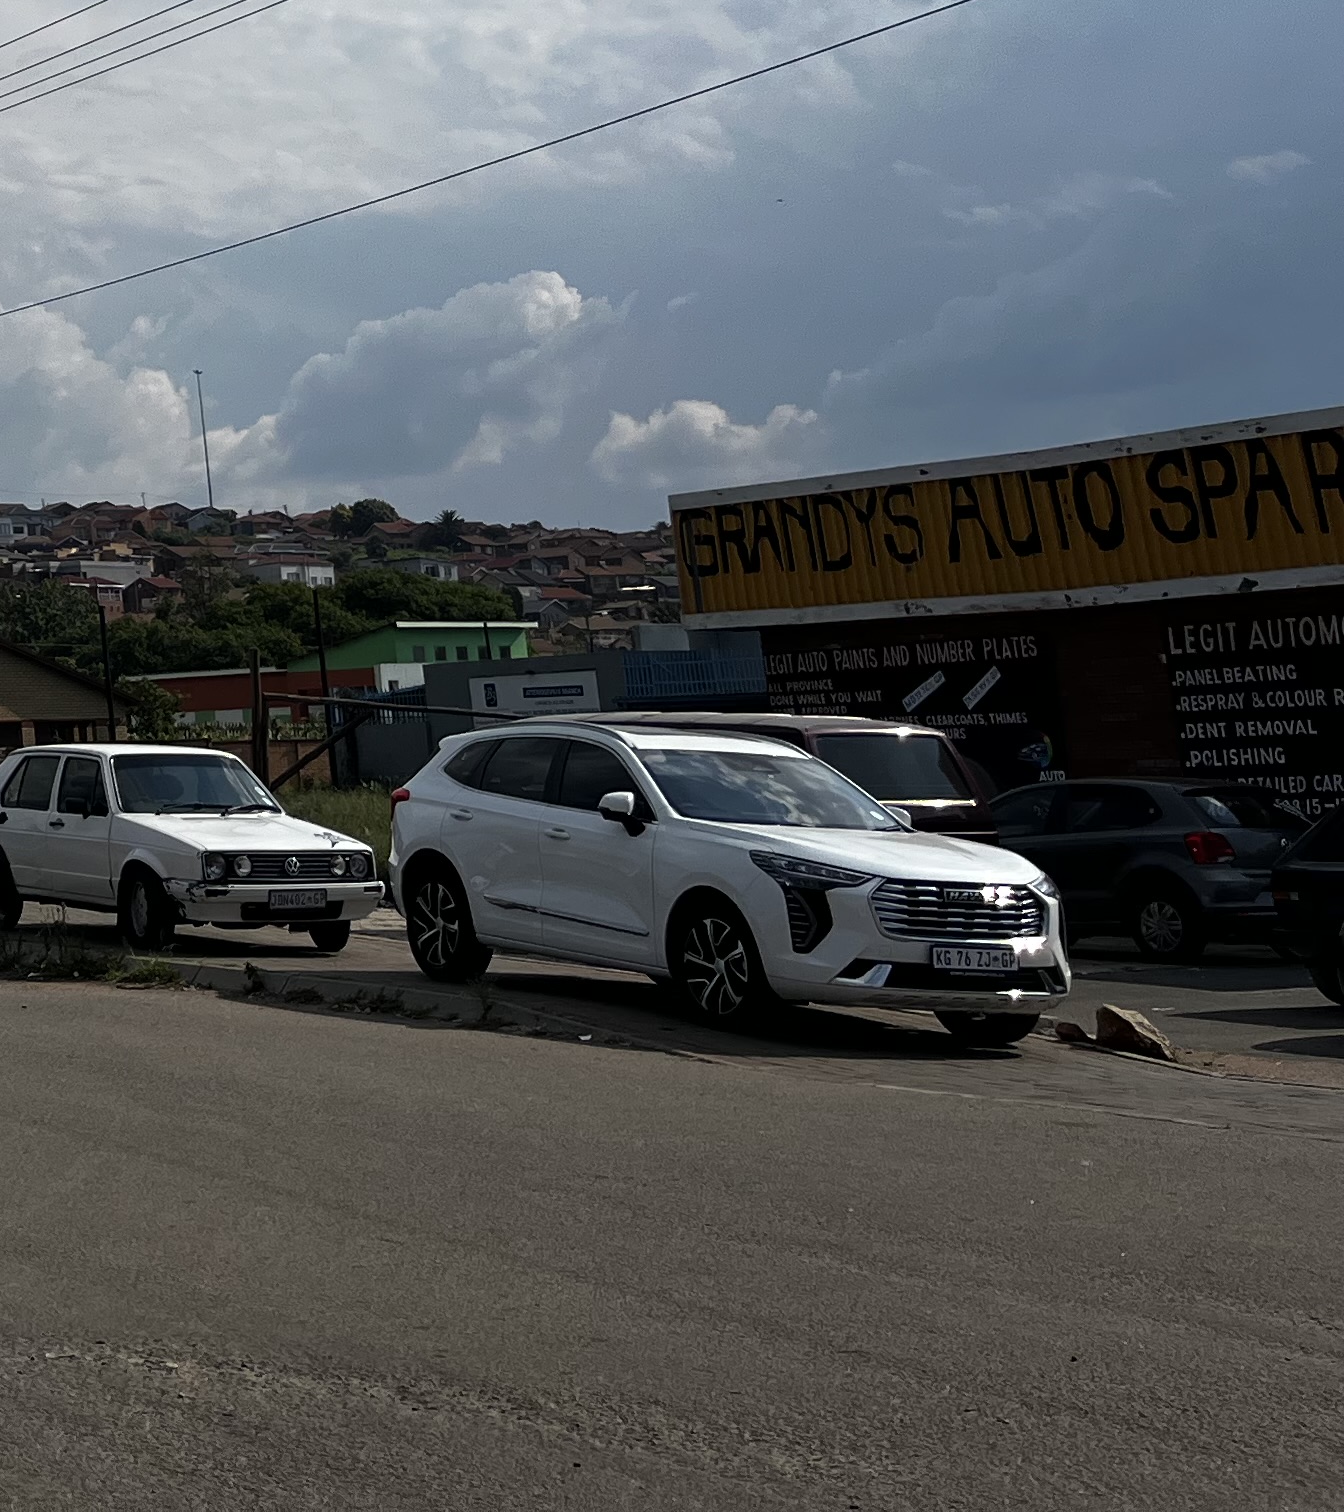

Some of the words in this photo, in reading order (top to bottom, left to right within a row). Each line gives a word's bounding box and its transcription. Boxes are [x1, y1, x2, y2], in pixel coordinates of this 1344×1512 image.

[679, 484, 923, 576] GRANDYS
[948, 460, 1125, 563] AUTO
[1168, 622, 1237, 654] LEGIT
[1248, 615, 1344, 650] AUTOM
[764, 653, 793, 675] LEGIT
[797, 651, 828, 673] AUTO
[833, 648, 878, 671] PAINTS
[883, 645, 909, 667] AND
[916, 639, 975, 665] NUMBER
[982, 635, 1038, 660] PLATES
[768, 682, 783, 692] ALL
[785, 679, 833, 692] PROVINCE
[769, 695, 794, 706] DONE
[796, 693, 826, 705] WHILE
[830, 692, 851, 703] YOU
[854, 689, 882, 703] WAIT
[1234, 719, 1318, 737] REMOVAL
[1039, 770, 1066, 782] AUTO
[936, 949, 951, 966] KG
[957, 950, 971, 967] 76
[977, 951, 991, 967] ZJ
[1001, 952, 1015, 968] GP
